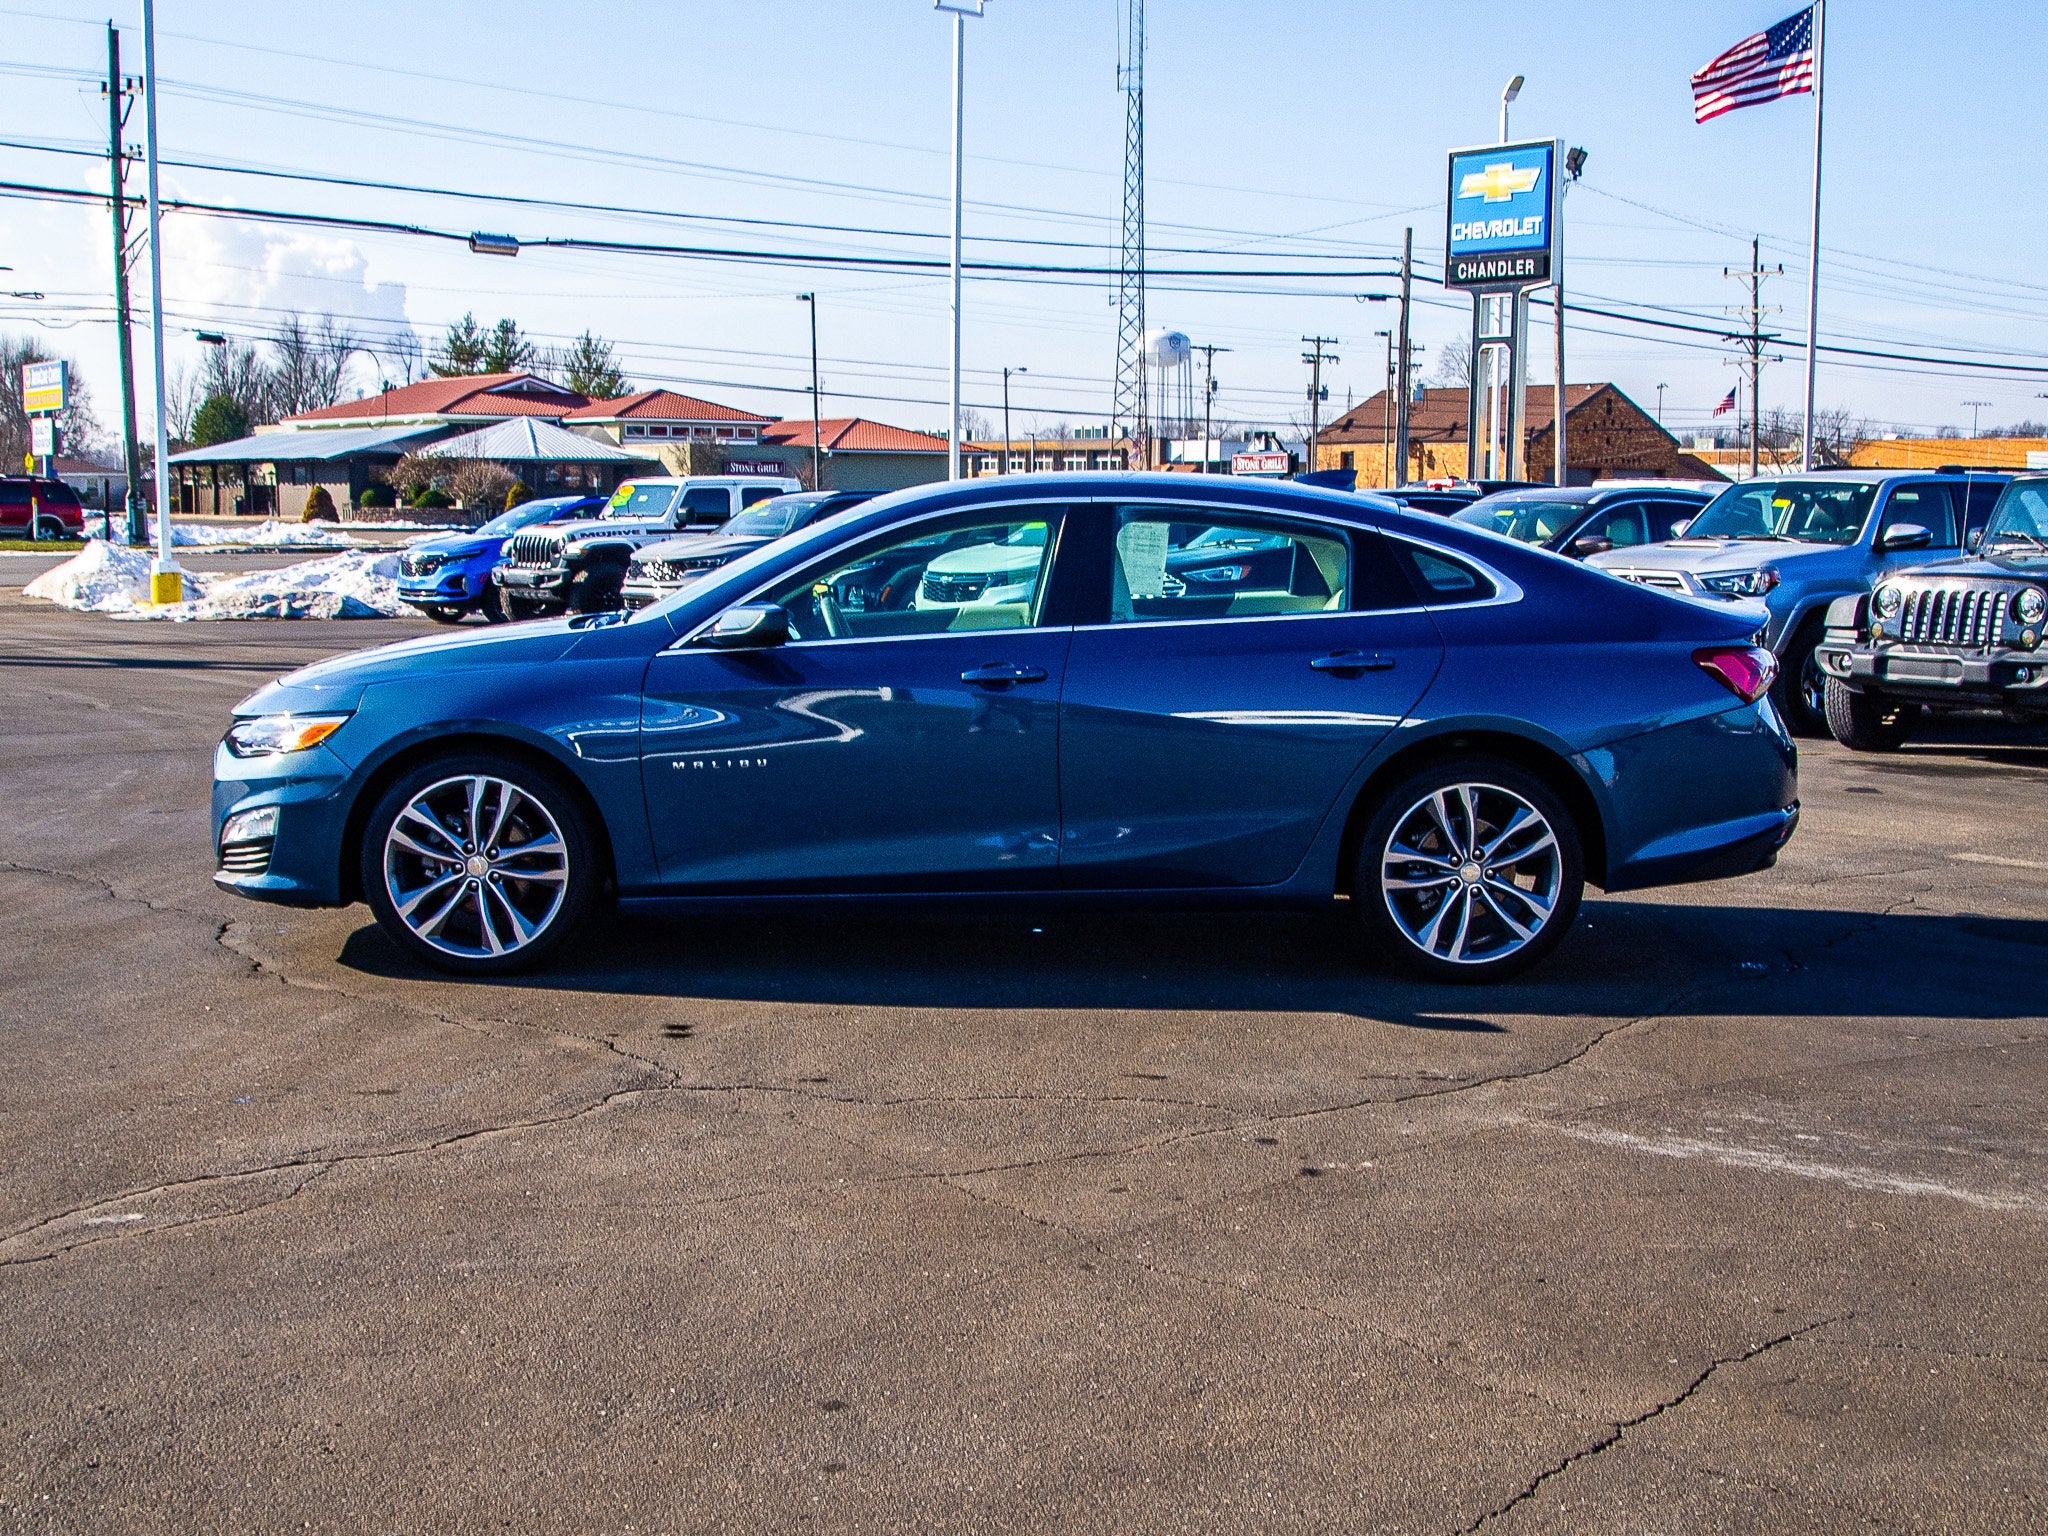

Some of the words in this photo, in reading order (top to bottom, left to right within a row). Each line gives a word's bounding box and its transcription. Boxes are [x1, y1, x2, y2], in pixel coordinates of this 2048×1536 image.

[1452, 215, 1544, 242] CHEVROLET
[1457, 258, 1535, 280] CHANDLER
[580, 529, 641, 538] MOJAVE
[672, 758, 767, 770] MALIBU
